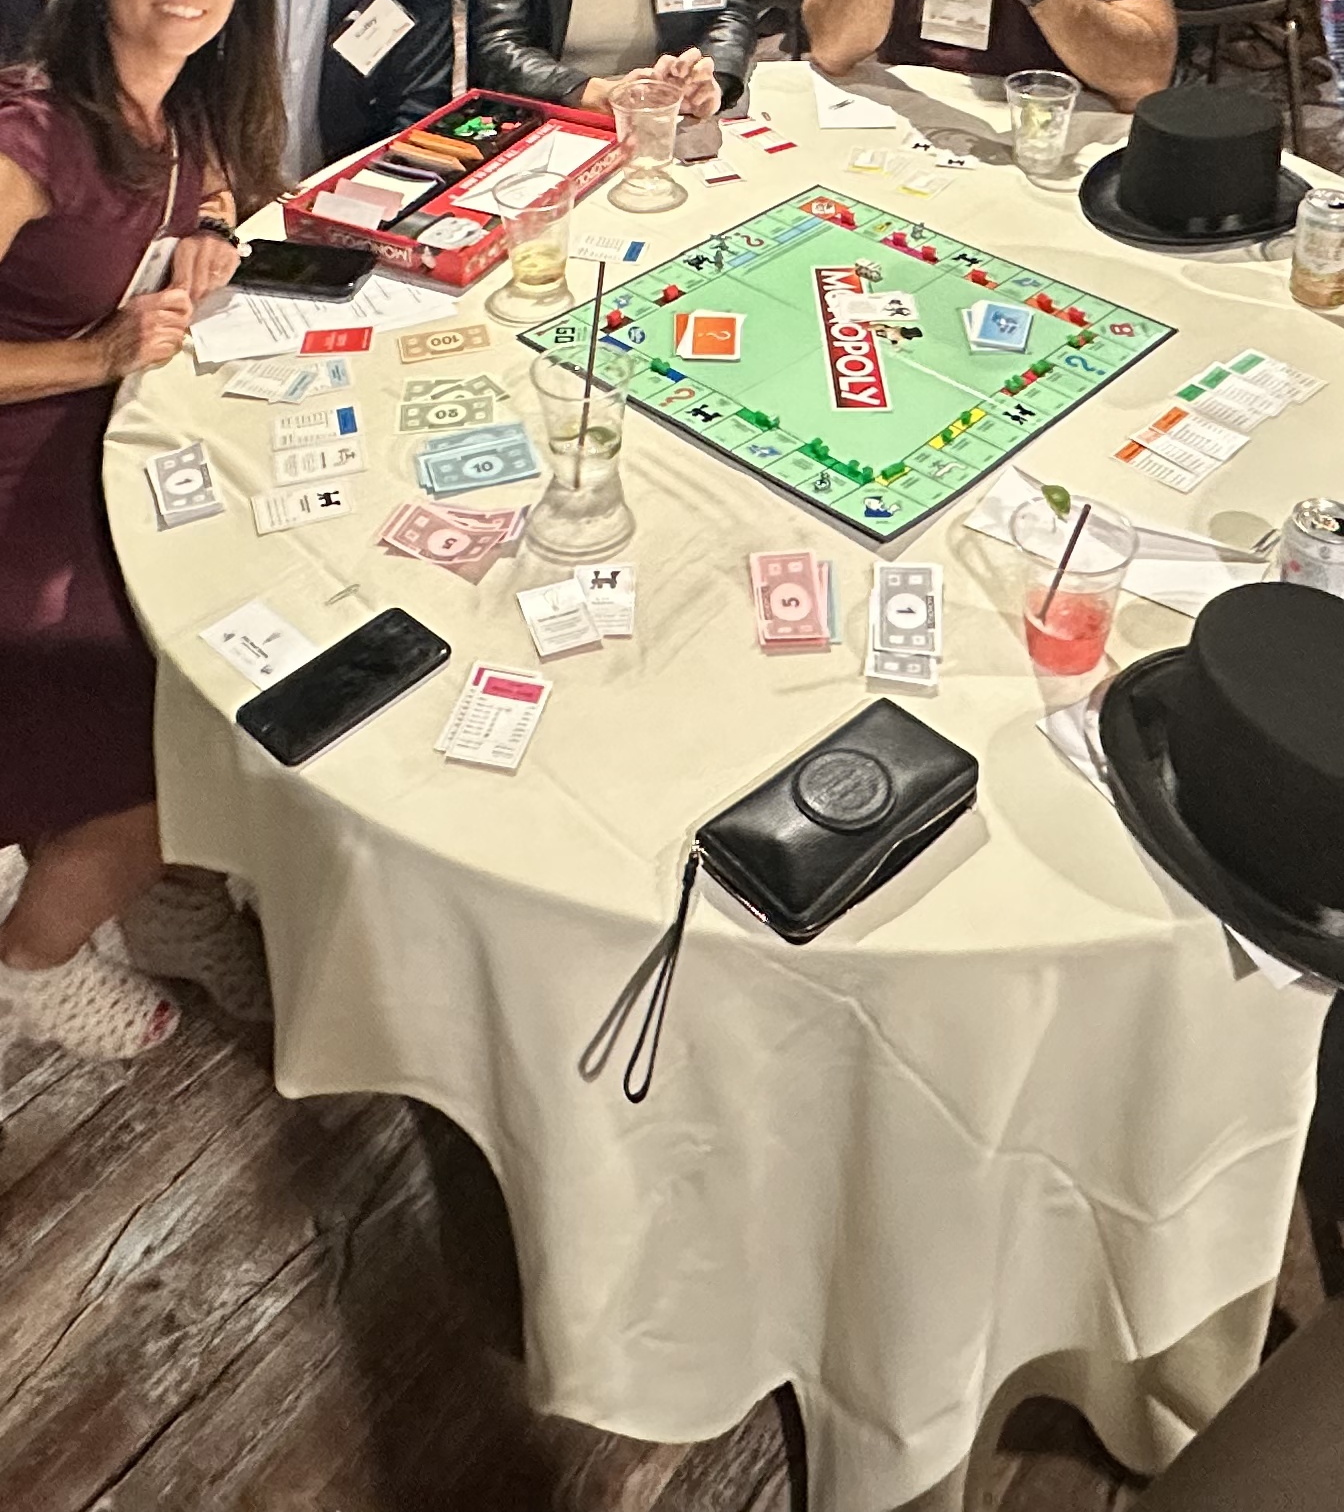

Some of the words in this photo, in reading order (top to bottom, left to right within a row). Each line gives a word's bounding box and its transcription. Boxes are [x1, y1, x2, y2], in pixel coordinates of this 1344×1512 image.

[430, 335, 460, 347] 100
[553, 326, 576, 344] GO
[820, 270, 881, 406] MOPOLY
[435, 408, 459, 420] 20
[472, 461, 493, 473] 10
[781, 596, 801, 609] 5
